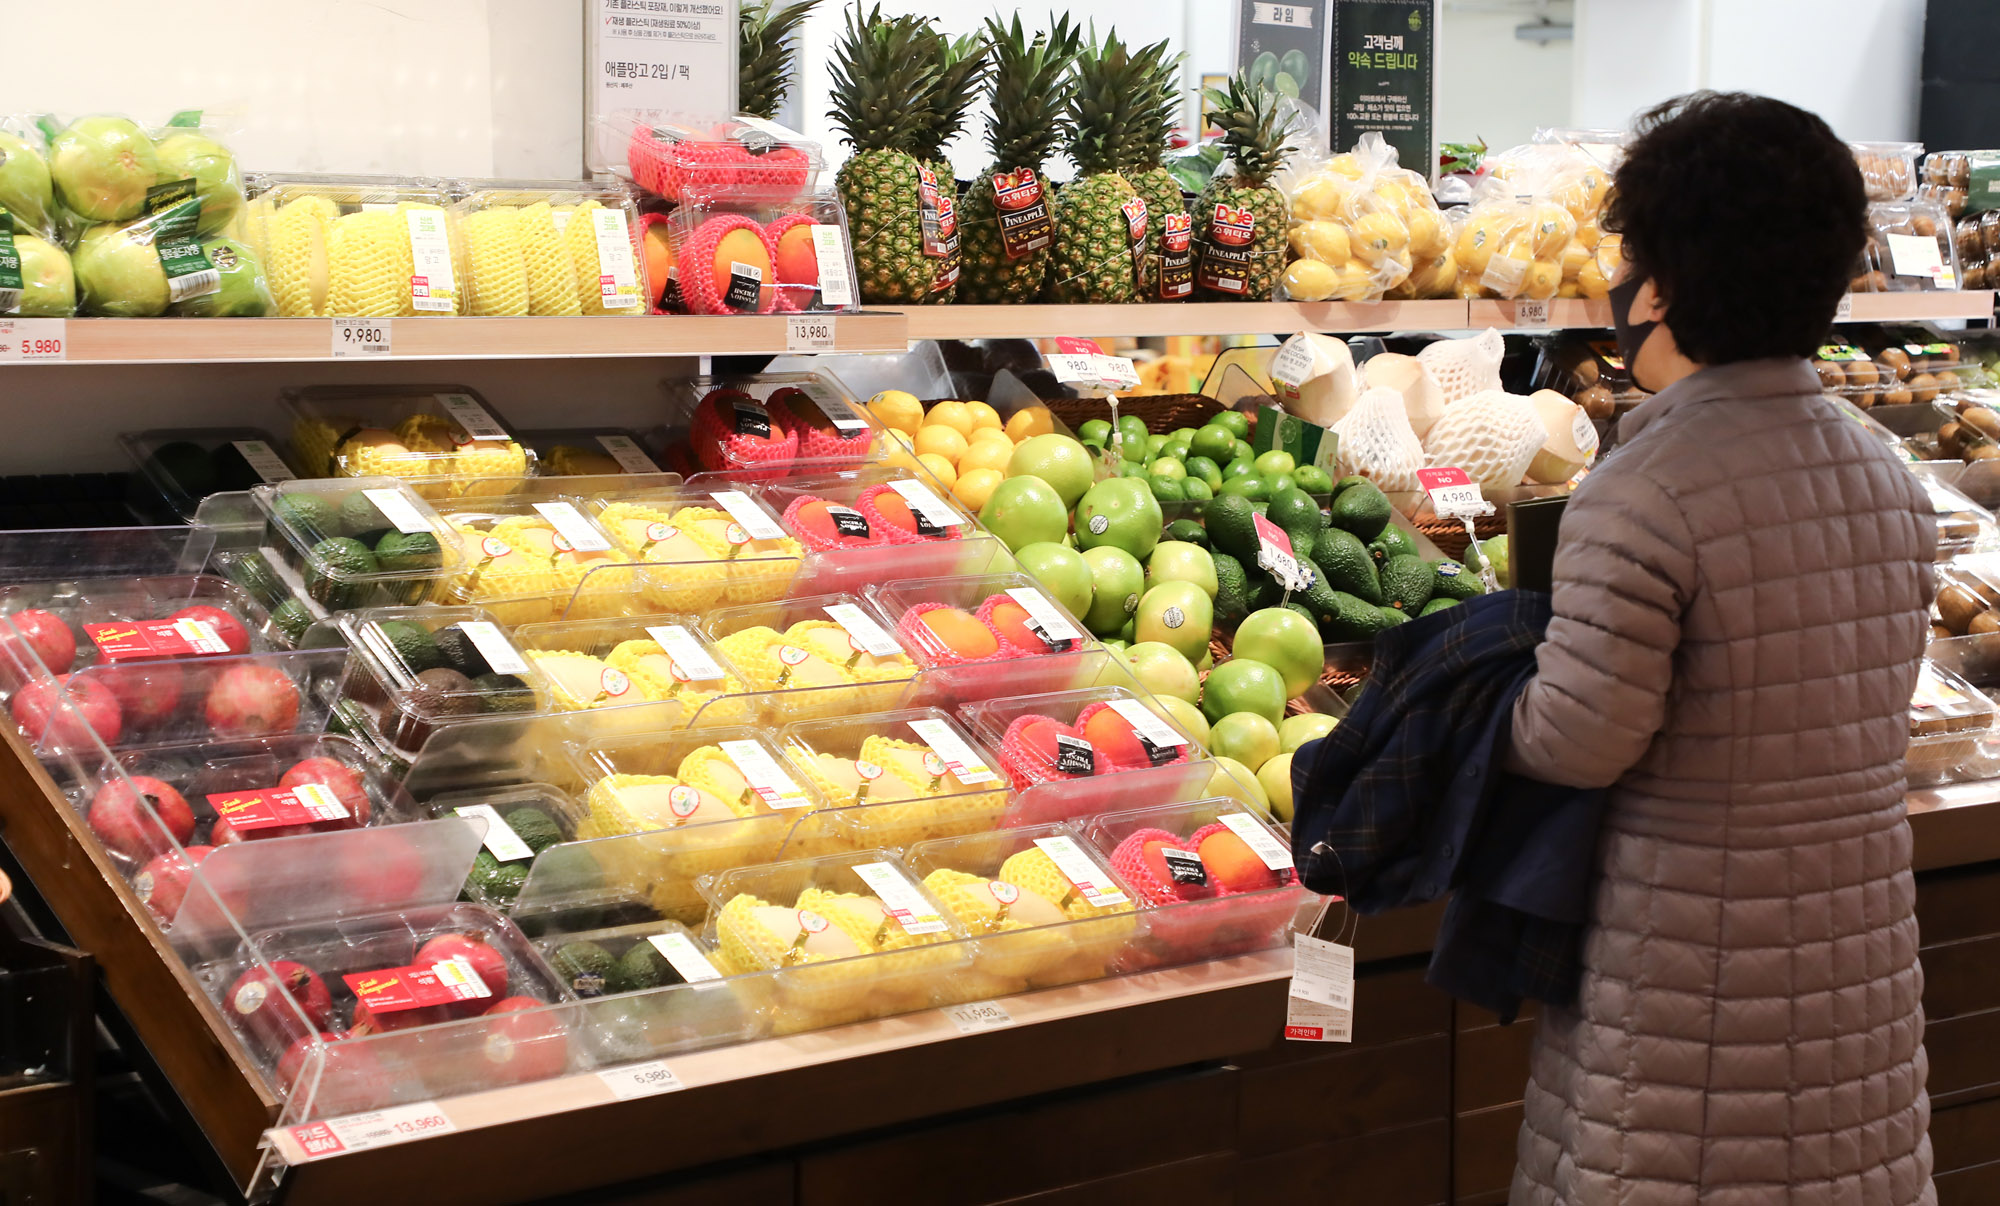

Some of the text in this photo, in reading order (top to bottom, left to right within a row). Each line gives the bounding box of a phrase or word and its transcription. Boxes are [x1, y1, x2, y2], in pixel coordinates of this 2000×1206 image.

[1363, 35, 1404, 50] 고객님께
[1348, 52, 1418, 70] 약속 드립니다
[605, 61, 649, 79] 애플망고
[651, 64, 669, 80] 2입
[679, 65, 690, 80] 팩
[993, 167, 1036, 193] Dole
[1000, 188, 1040, 205] 스위티오
[1003, 205, 1045, 228] PINEAPPLE
[1166, 212, 1192, 233] Dole
[1214, 204, 1254, 228] Dole
[1212, 227, 1252, 240] 스위티오
[1207, 246, 1248, 262] PINEAPPLE
[343, 328, 382, 344] 9,980
[795, 325, 828, 341] 13,980
[21, 339, 62, 354] 5,980
[1067, 360, 1088, 371] 980
[1108, 362, 1129, 373] 980
[1441, 491, 1473, 503] 4,980
[1270, 547, 1293, 570] 1,680
[954, 1007, 998, 1021] 11,980
[1290, 1027, 1318, 1037] 가격인하
[633, 1069, 673, 1084] 6,980
[393, 1115, 446, 1135] 13,960
[296, 1125, 329, 1142] 카드
[304, 1137, 339, 1154] 행사
